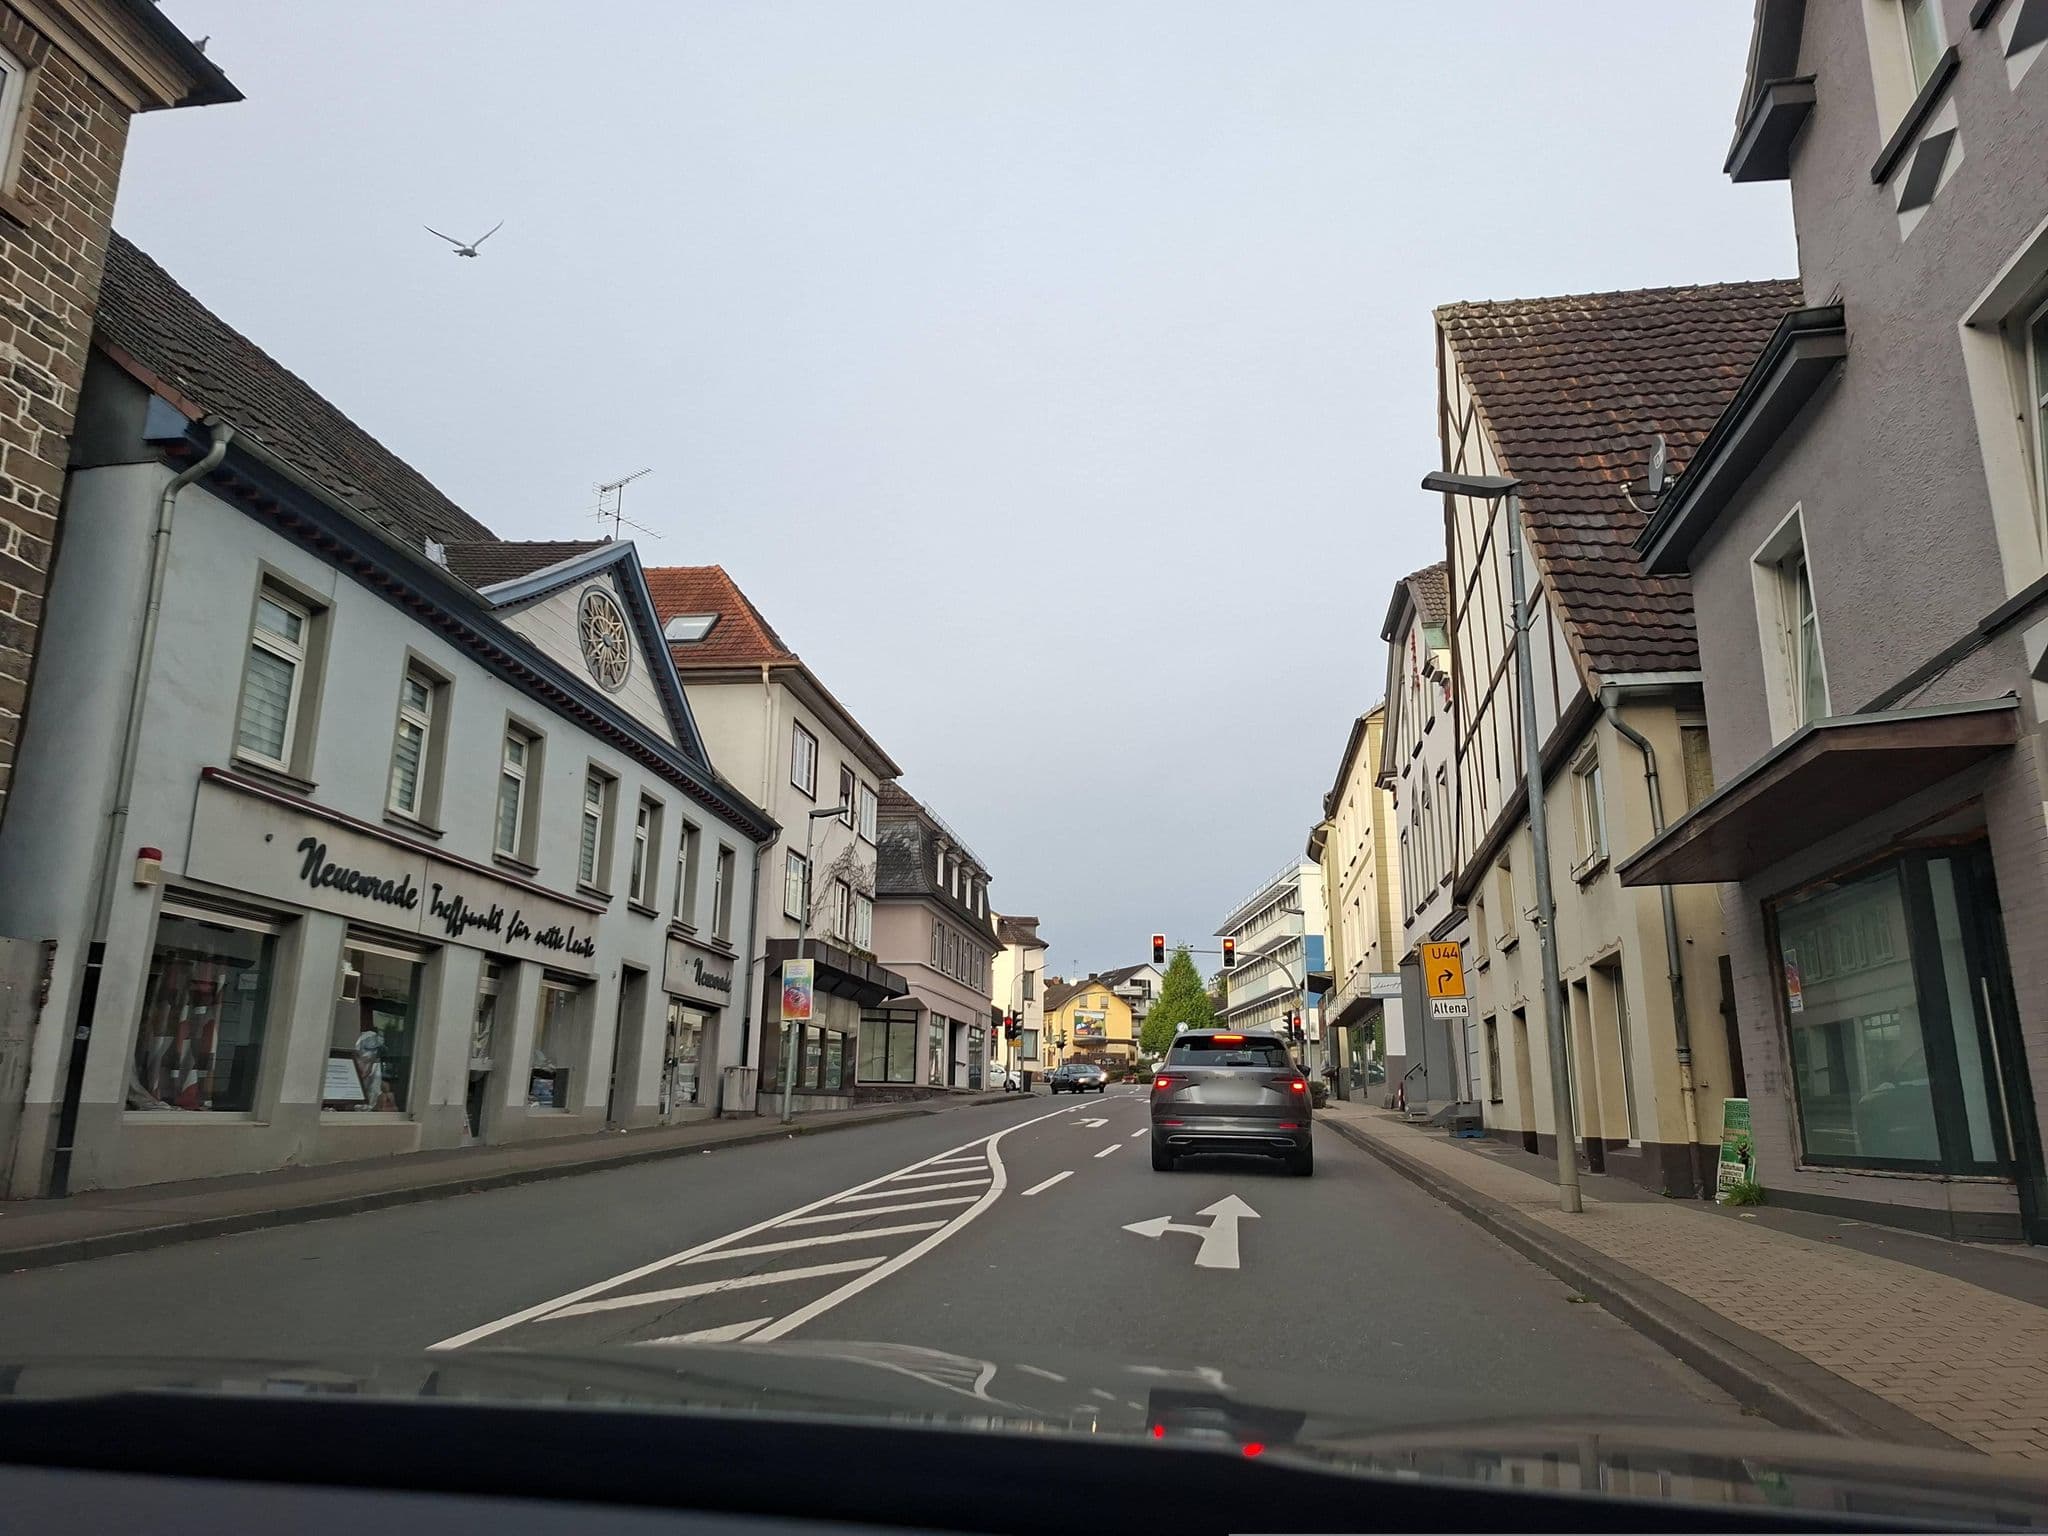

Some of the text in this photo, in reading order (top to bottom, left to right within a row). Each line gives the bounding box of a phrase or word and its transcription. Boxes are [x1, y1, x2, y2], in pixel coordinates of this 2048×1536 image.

[297, 837, 595, 957] Neuenrade Treffpunkt für nette Leute
[1431, 947, 1458, 959] U44
[1433, 1003, 1467, 1014] Altena
